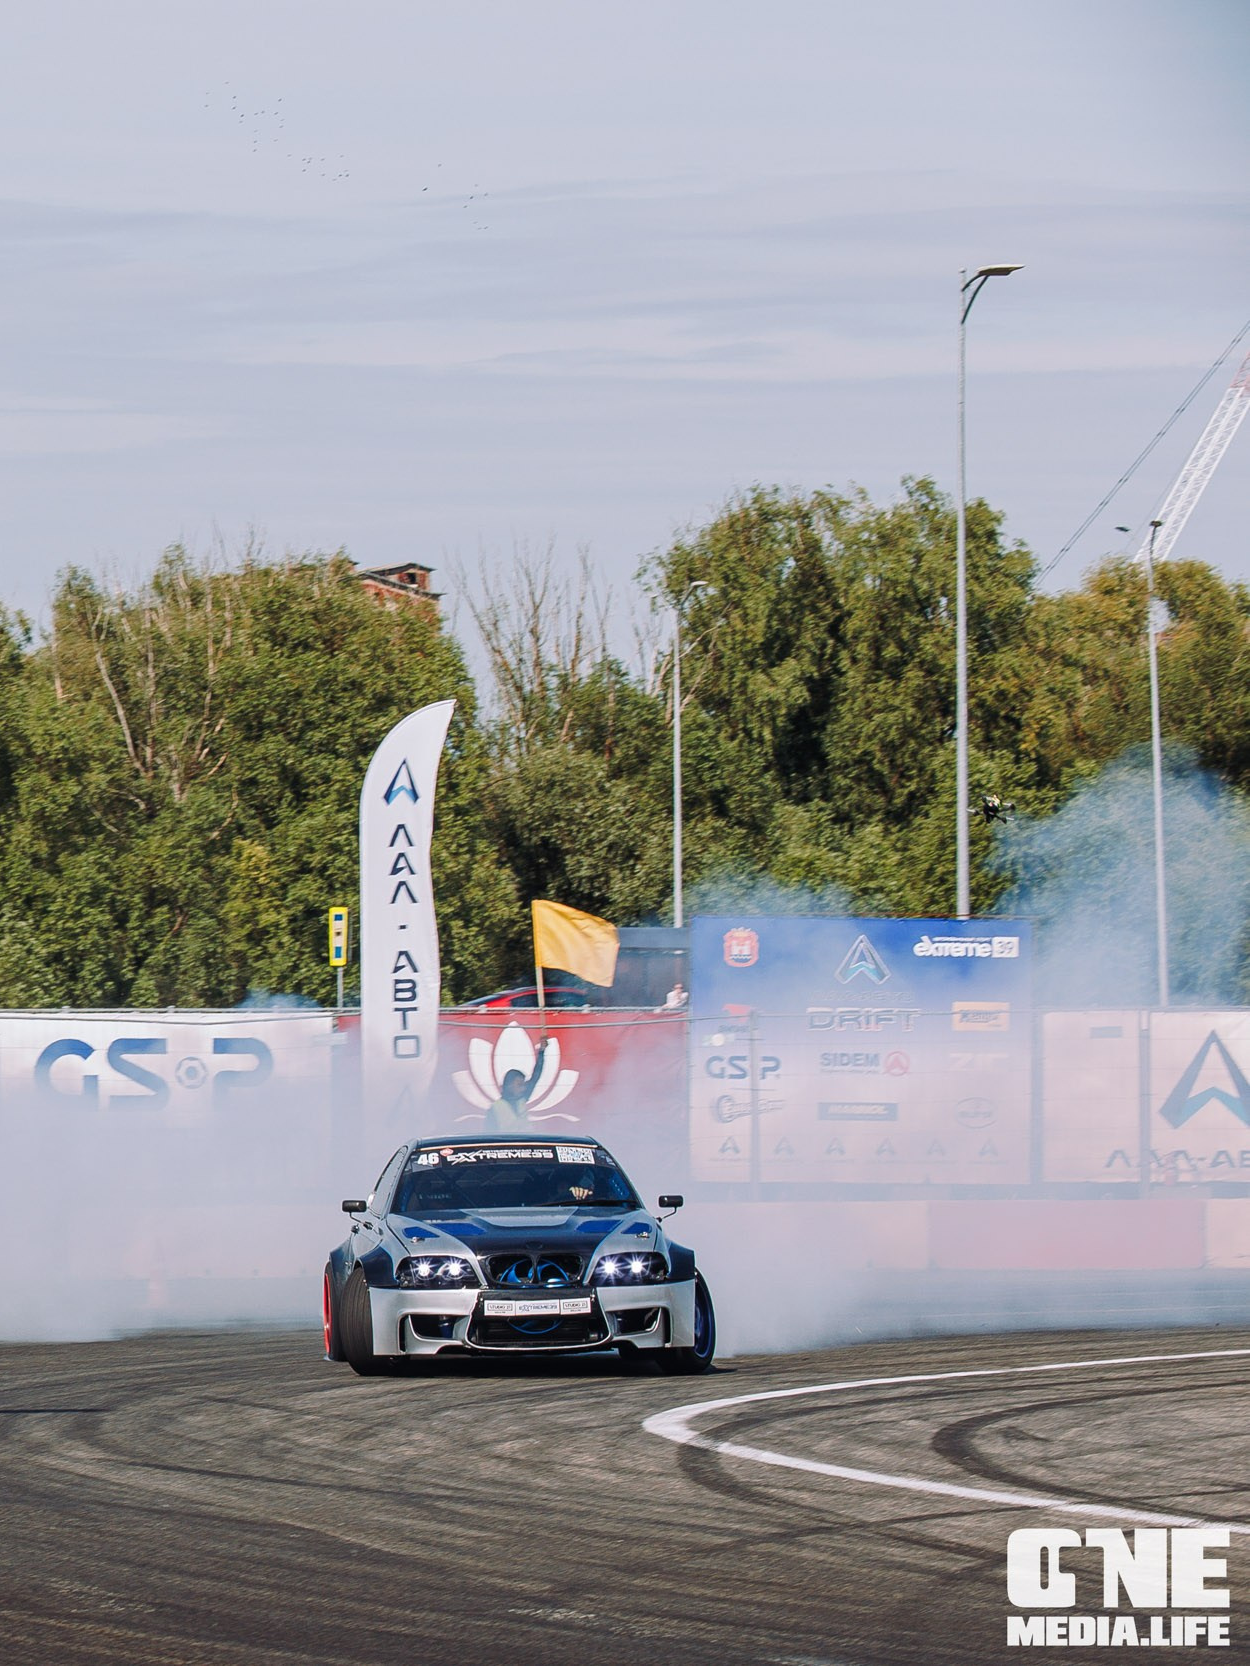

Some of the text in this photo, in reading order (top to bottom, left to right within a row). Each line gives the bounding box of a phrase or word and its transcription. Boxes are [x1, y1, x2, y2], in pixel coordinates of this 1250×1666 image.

[806, 1007, 922, 1032] DRIFT
[706, 1055, 782, 1080] GSP
[819, 1052, 881, 1067] SIDEM
[34, 1037, 274, 1112] GSP
[417, 1152, 441, 1166] 46
